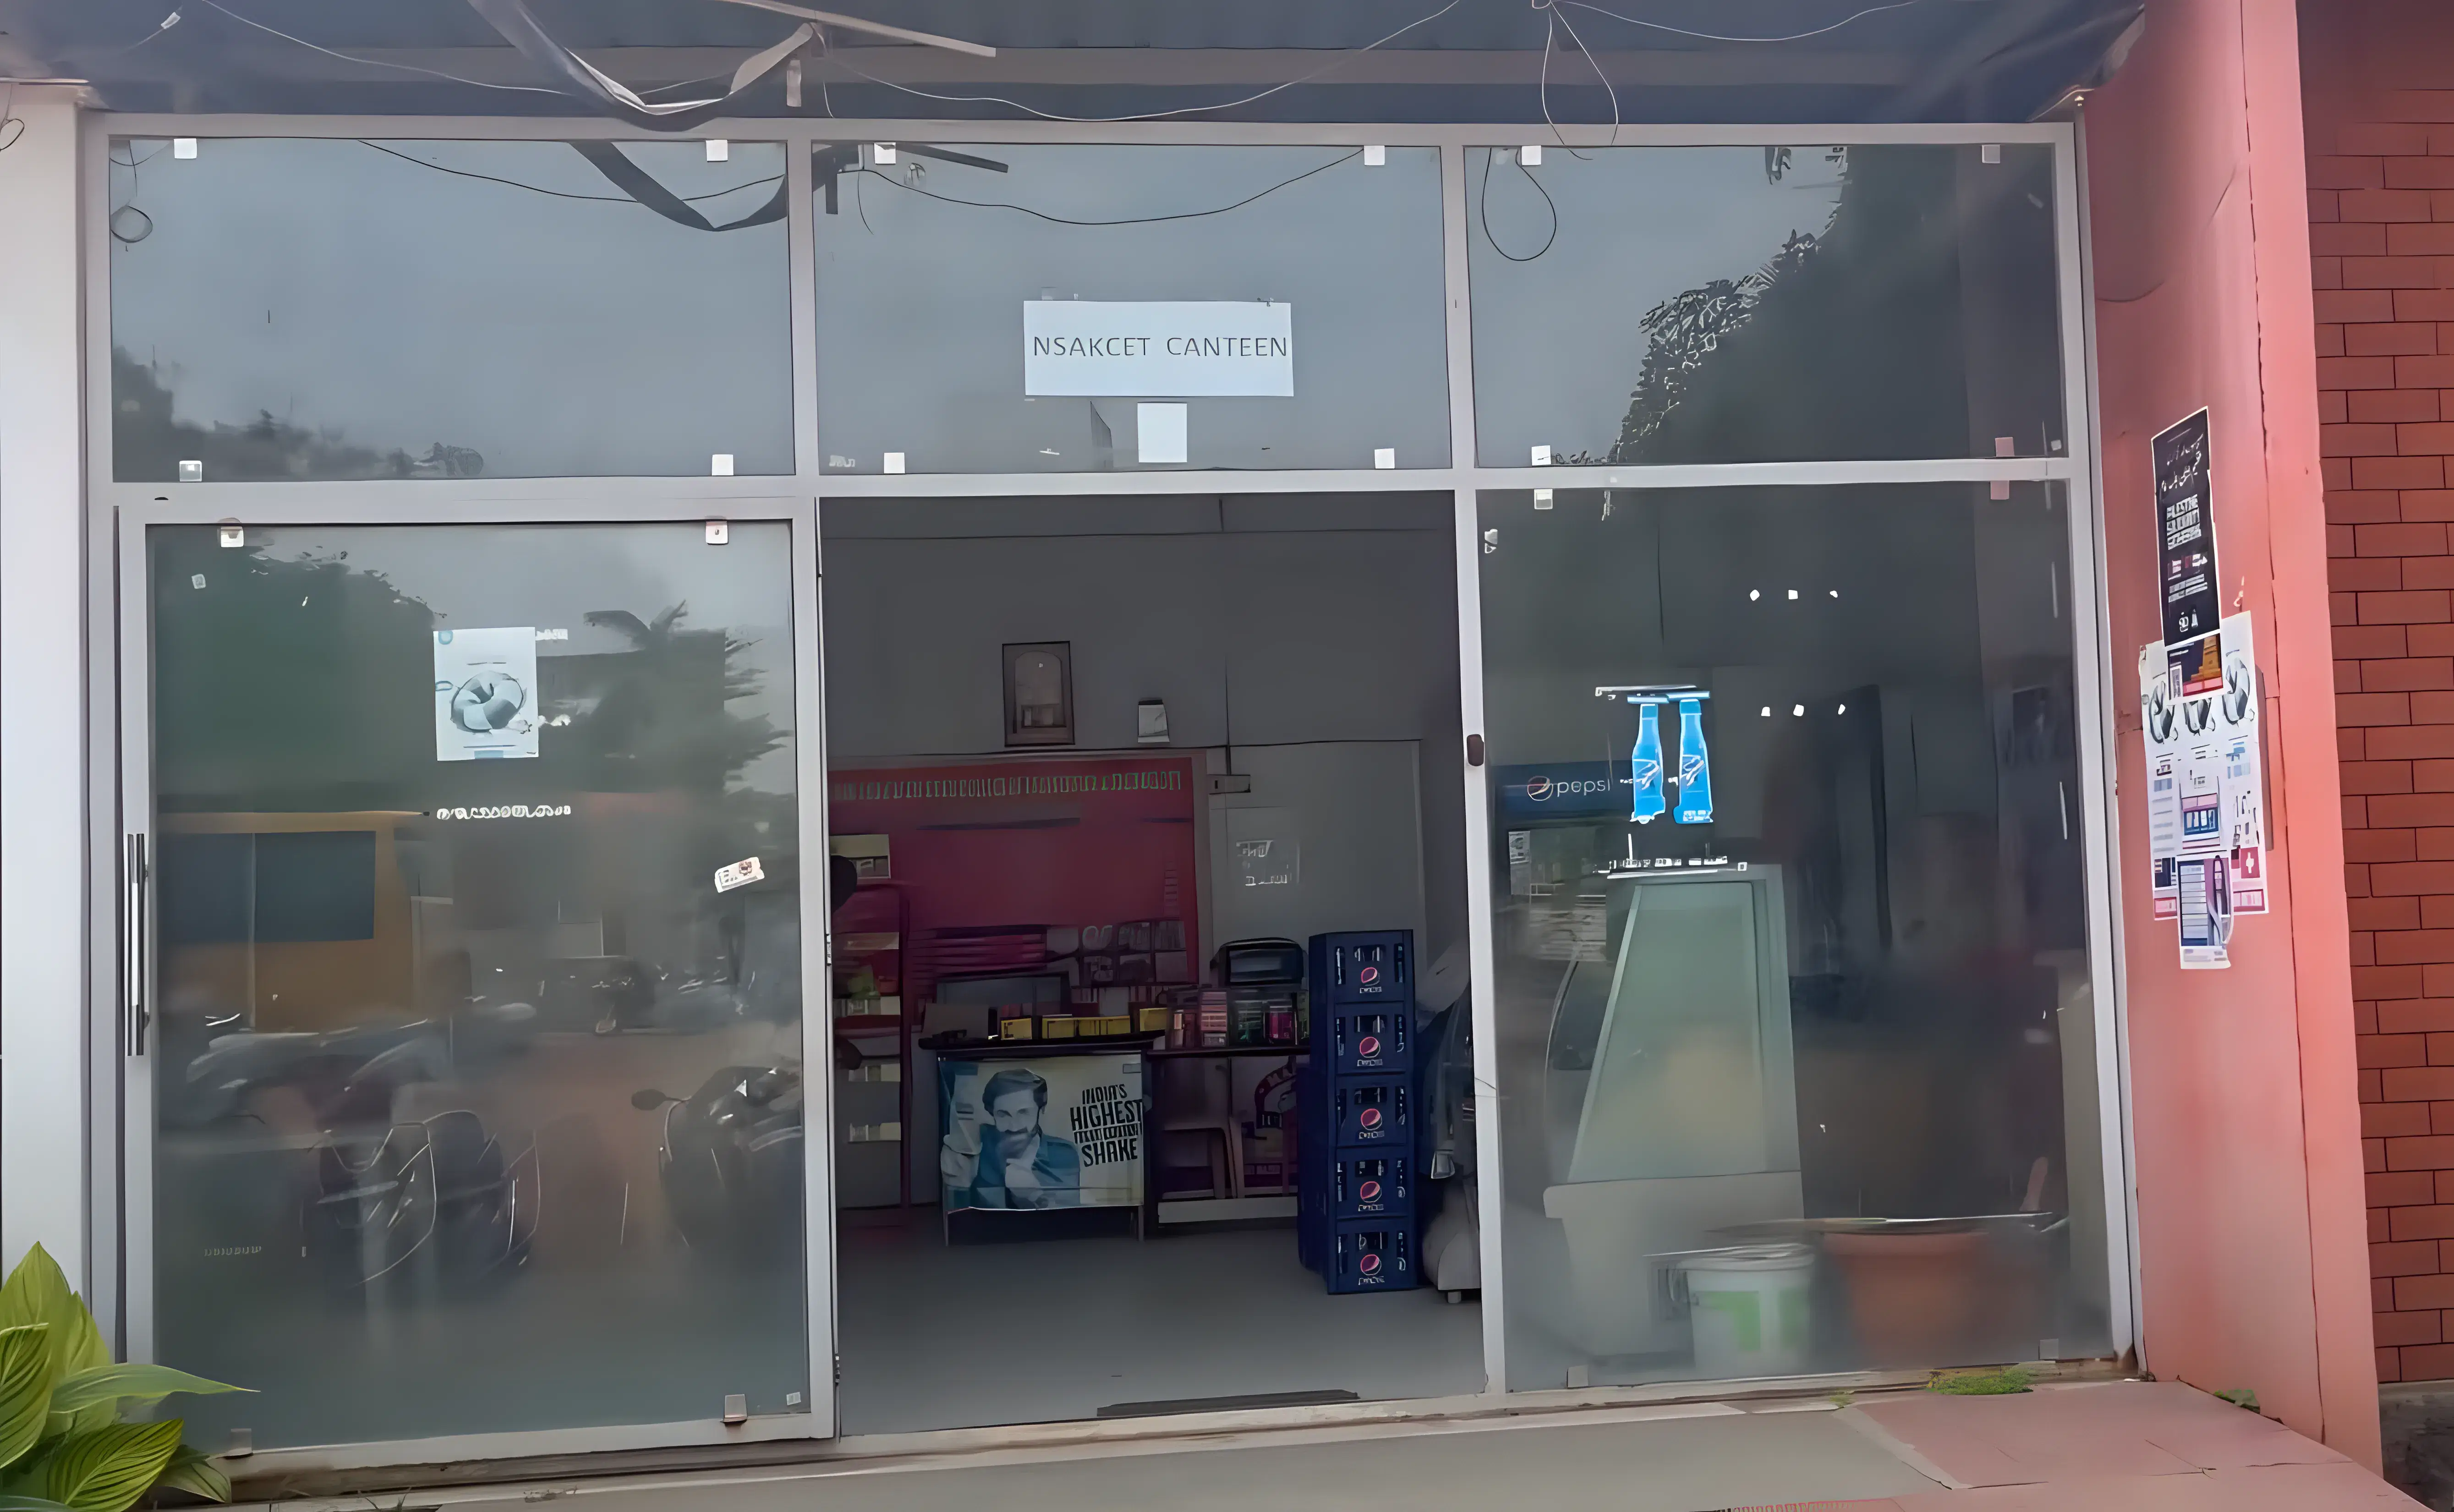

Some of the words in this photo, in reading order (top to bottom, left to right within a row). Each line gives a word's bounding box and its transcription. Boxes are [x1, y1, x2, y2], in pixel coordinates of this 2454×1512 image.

[1034, 336, 1150, 357] NSAKCET
[1167, 336, 1287, 357] CANTEEN
[1557, 778, 1610, 798] pepsi
[1070, 1099, 1143, 1131] HIGHEST
[1081, 1138, 1138, 1167] SHAKE
